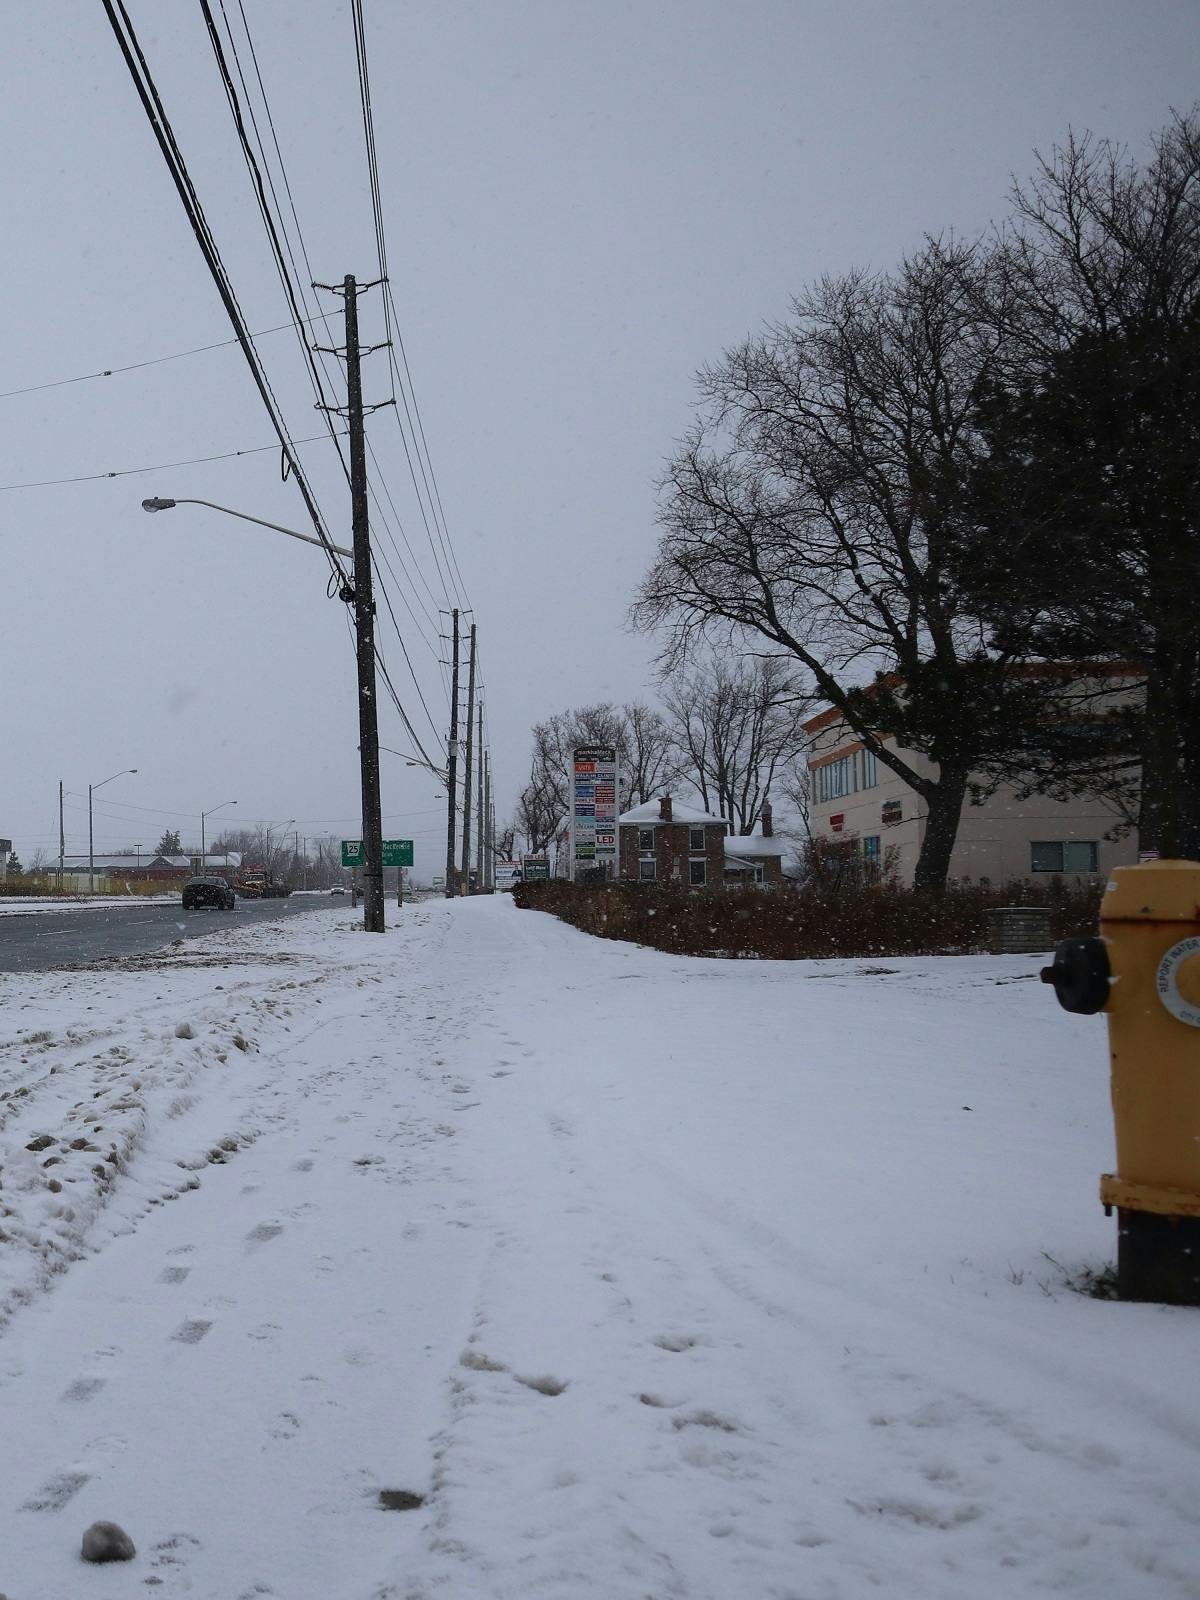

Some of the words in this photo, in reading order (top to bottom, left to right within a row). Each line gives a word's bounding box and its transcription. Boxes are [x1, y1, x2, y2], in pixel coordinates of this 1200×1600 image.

[596, 836, 614, 844] LED
[349, 845, 359, 854] 25
[1159, 957, 1173, 993] REPORT
[1170, 938, 1200, 959] WATER
